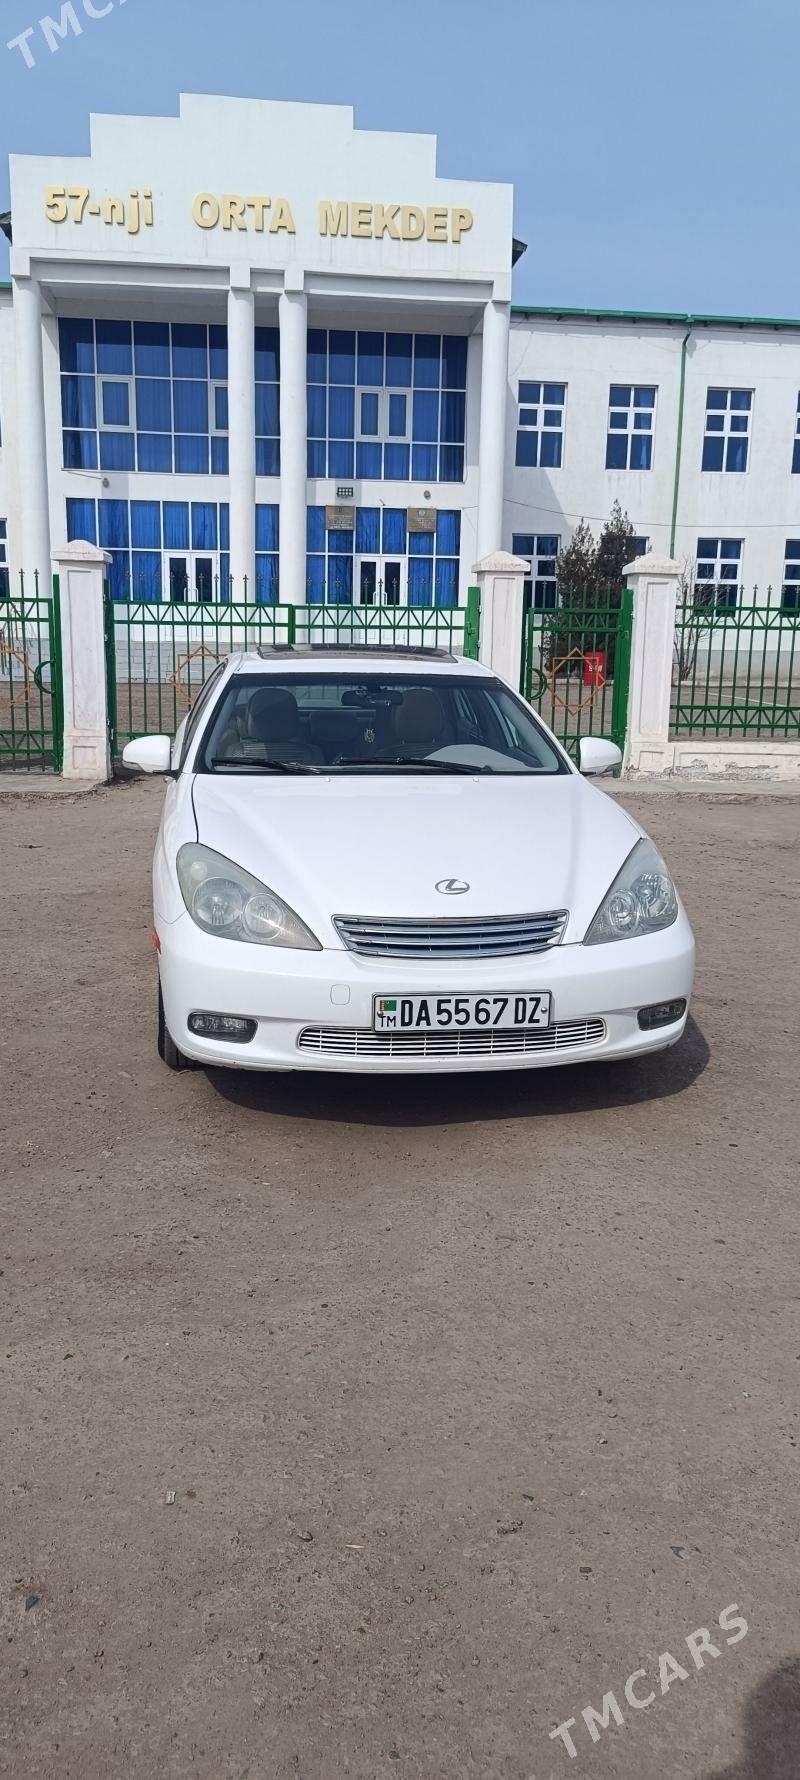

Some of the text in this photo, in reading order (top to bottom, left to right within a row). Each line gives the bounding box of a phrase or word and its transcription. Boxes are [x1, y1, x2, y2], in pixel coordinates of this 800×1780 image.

[46, 186, 474, 243] 57-nji ORTA MEKDEP
[378, 1014, 397, 1028] TM
[513, 996, 542, 1025] DZ
